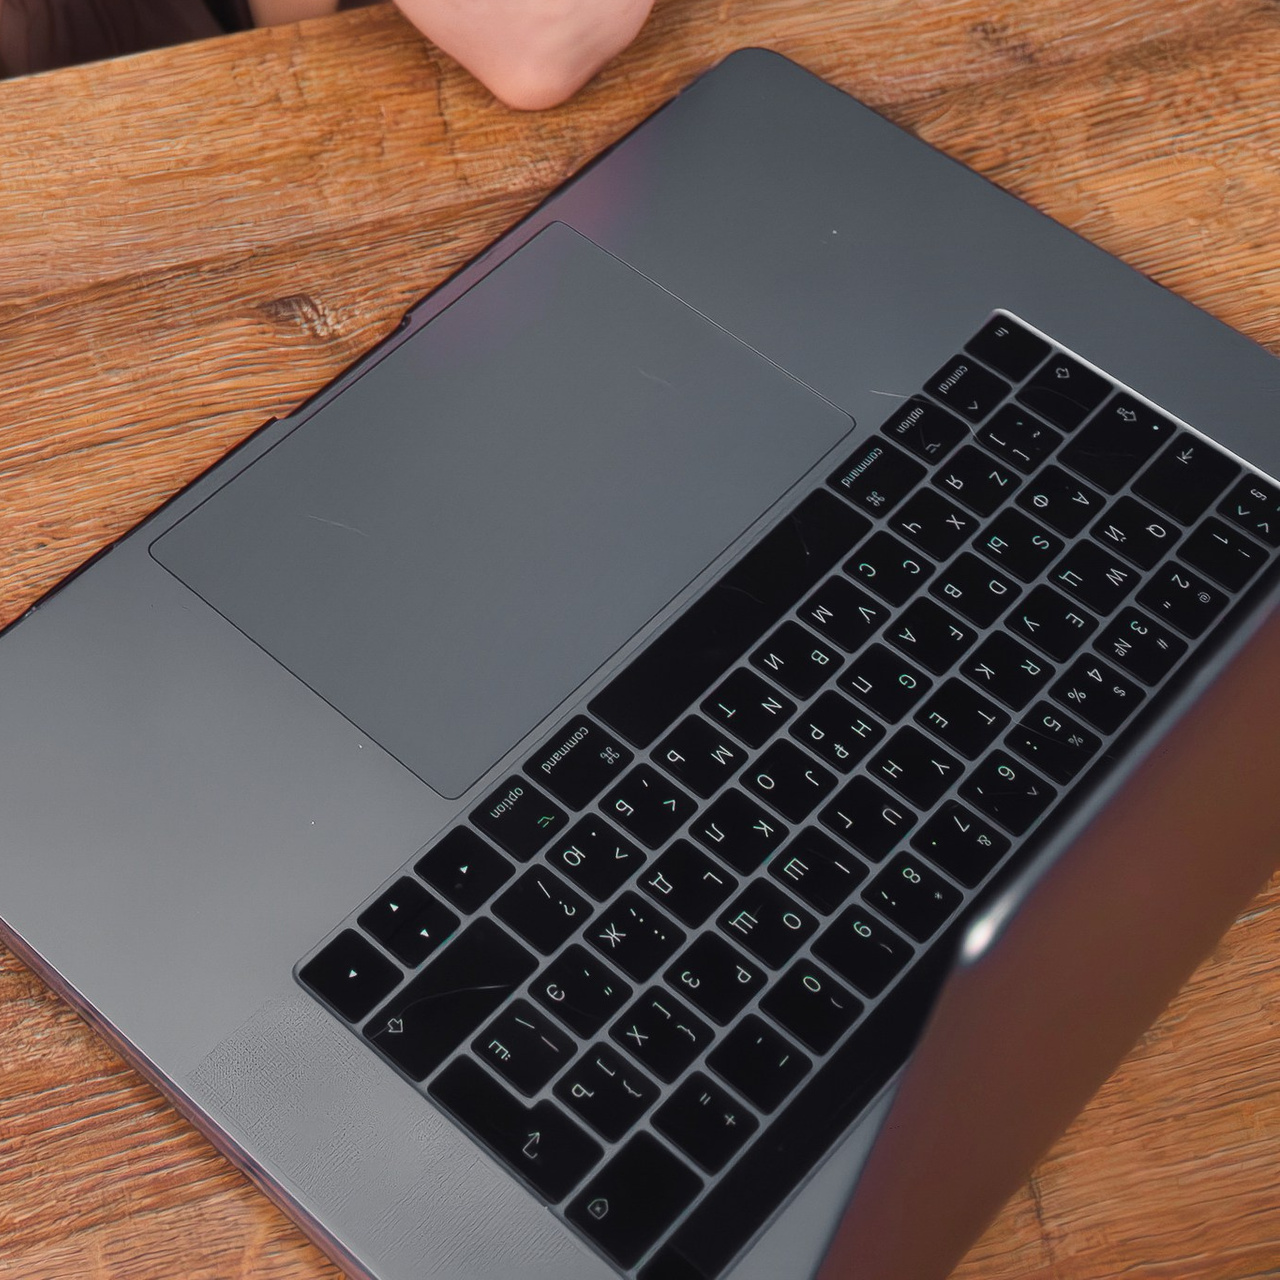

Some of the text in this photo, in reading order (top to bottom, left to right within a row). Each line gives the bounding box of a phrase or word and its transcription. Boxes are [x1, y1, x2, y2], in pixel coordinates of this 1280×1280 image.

[938, 366, 968, 394] control
[897, 408, 924, 433] option
[841, 448, 883, 488] command
[1213, 534, 1228, 544] 1
[1171, 574, 1189, 588] 2
[1131, 621, 1148, 634] 3
[1087, 669, 1102, 682] 4
[1043, 716, 1061, 731] 5
[541, 727, 588, 774] command
[998, 766, 1015, 781] 6
[490, 788, 523, 818] option
[954, 816, 970, 832] 7
[902, 868, 921, 883] 8
[853, 921, 871, 937] 9
[803, 976, 821, 992] 0
